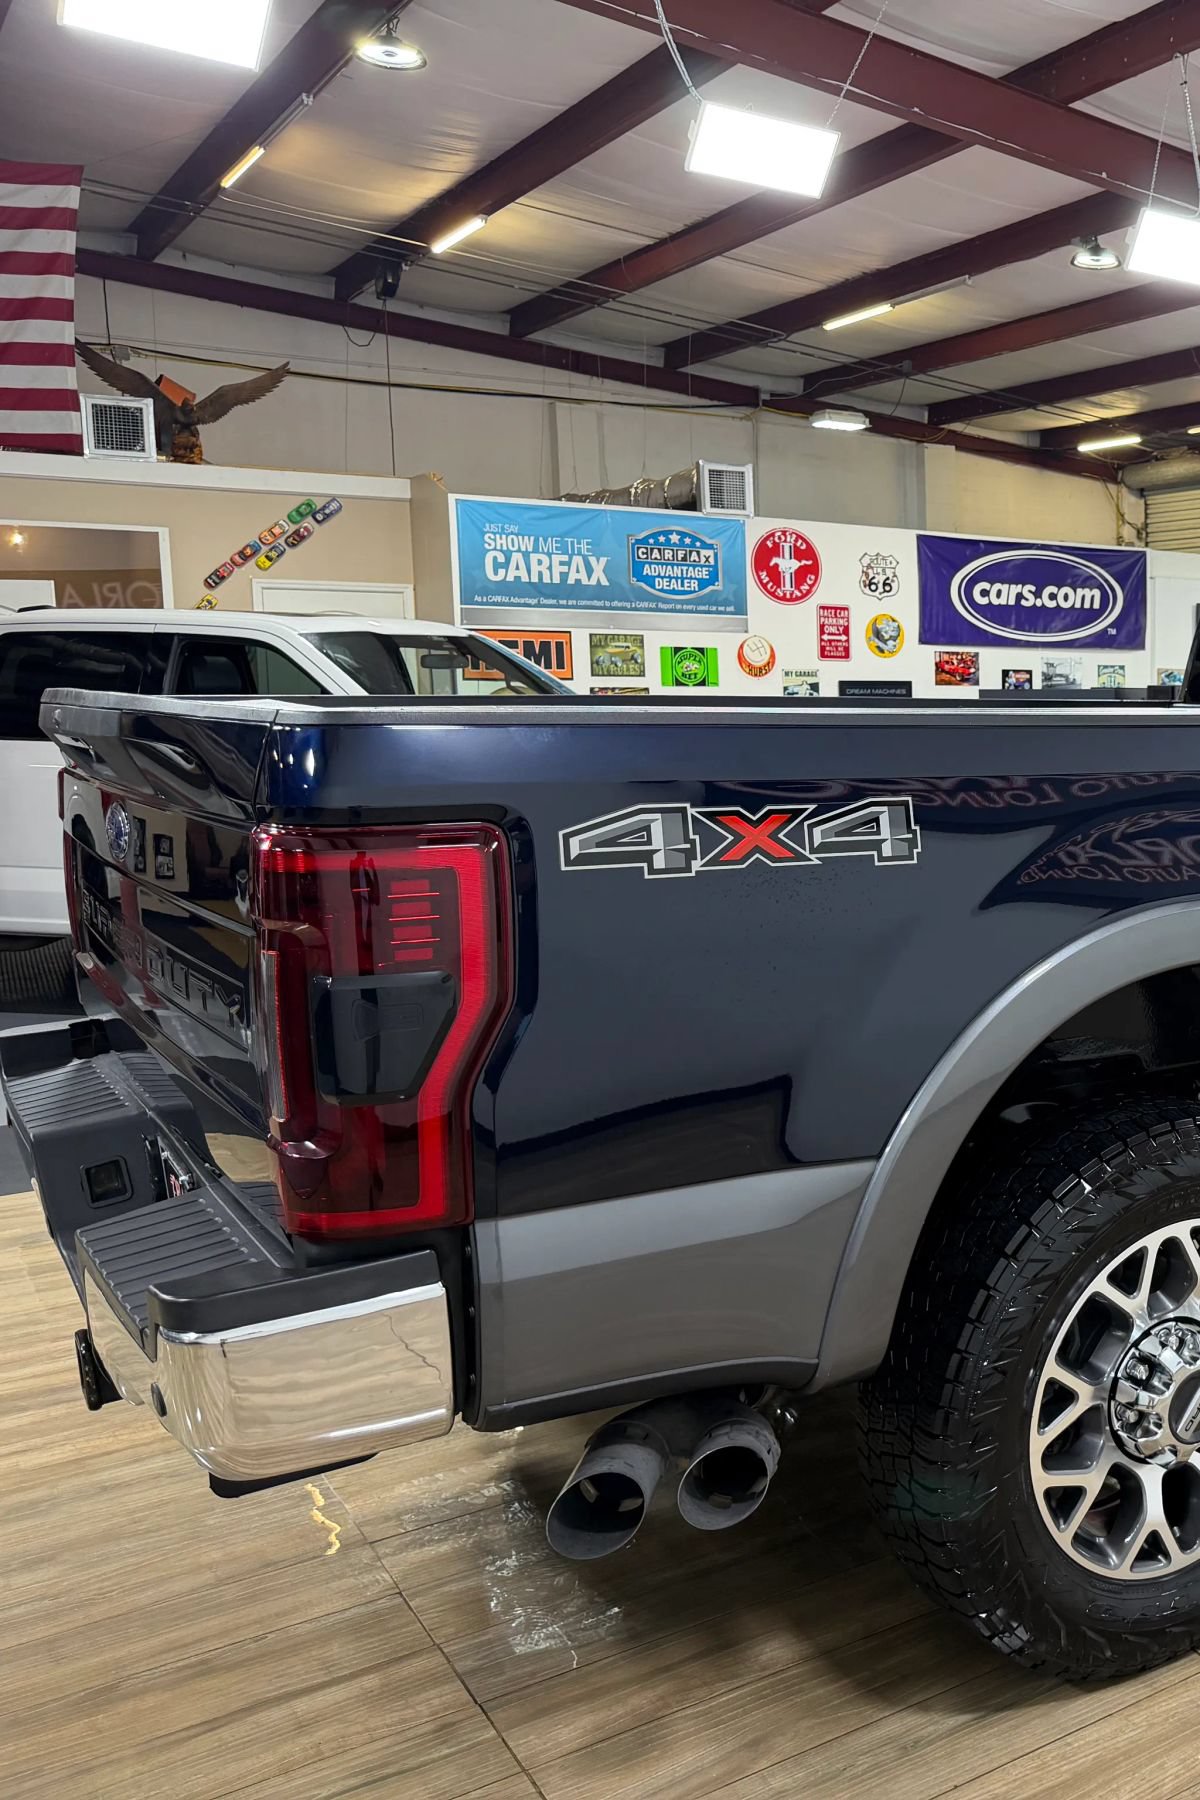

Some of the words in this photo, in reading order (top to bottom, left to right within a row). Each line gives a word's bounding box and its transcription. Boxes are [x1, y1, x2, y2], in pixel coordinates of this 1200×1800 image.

[483, 523, 502, 533] JUST
[504, 524, 519, 534] SAY
[483, 533, 535, 552] SHOW
[538, 537, 562, 554] ME
[564, 537, 593, 556] THE
[766, 531, 807, 550] FORD
[637, 547, 712, 564] CARFAX
[484, 550, 610, 586] CARFAX
[642, 564, 711, 580] ADVANTAGE
[655, 577, 699, 591] DEALER
[759, 569, 816, 599] MUSTANG
[868, 576, 893, 593] 66
[474, 595, 482, 603] As
[488, 595, 510, 603] CARFAX
[578, 599, 604, 607] committed
[611, 600, 631, 609] offering
[972, 581, 1101, 610] cars.com
[820, 609, 835, 617] RACE
[837, 610, 849, 618] CAR
[820, 617, 849, 626] PARKING
[824, 626, 844, 634] ONLY
[607, 635, 642, 647] GARAGE
[747, 662, 772, 678] HURST
[784, 670, 794, 678] MY
[795, 670, 818, 678] GARAGE
[558, 797, 921, 879] 4X4
